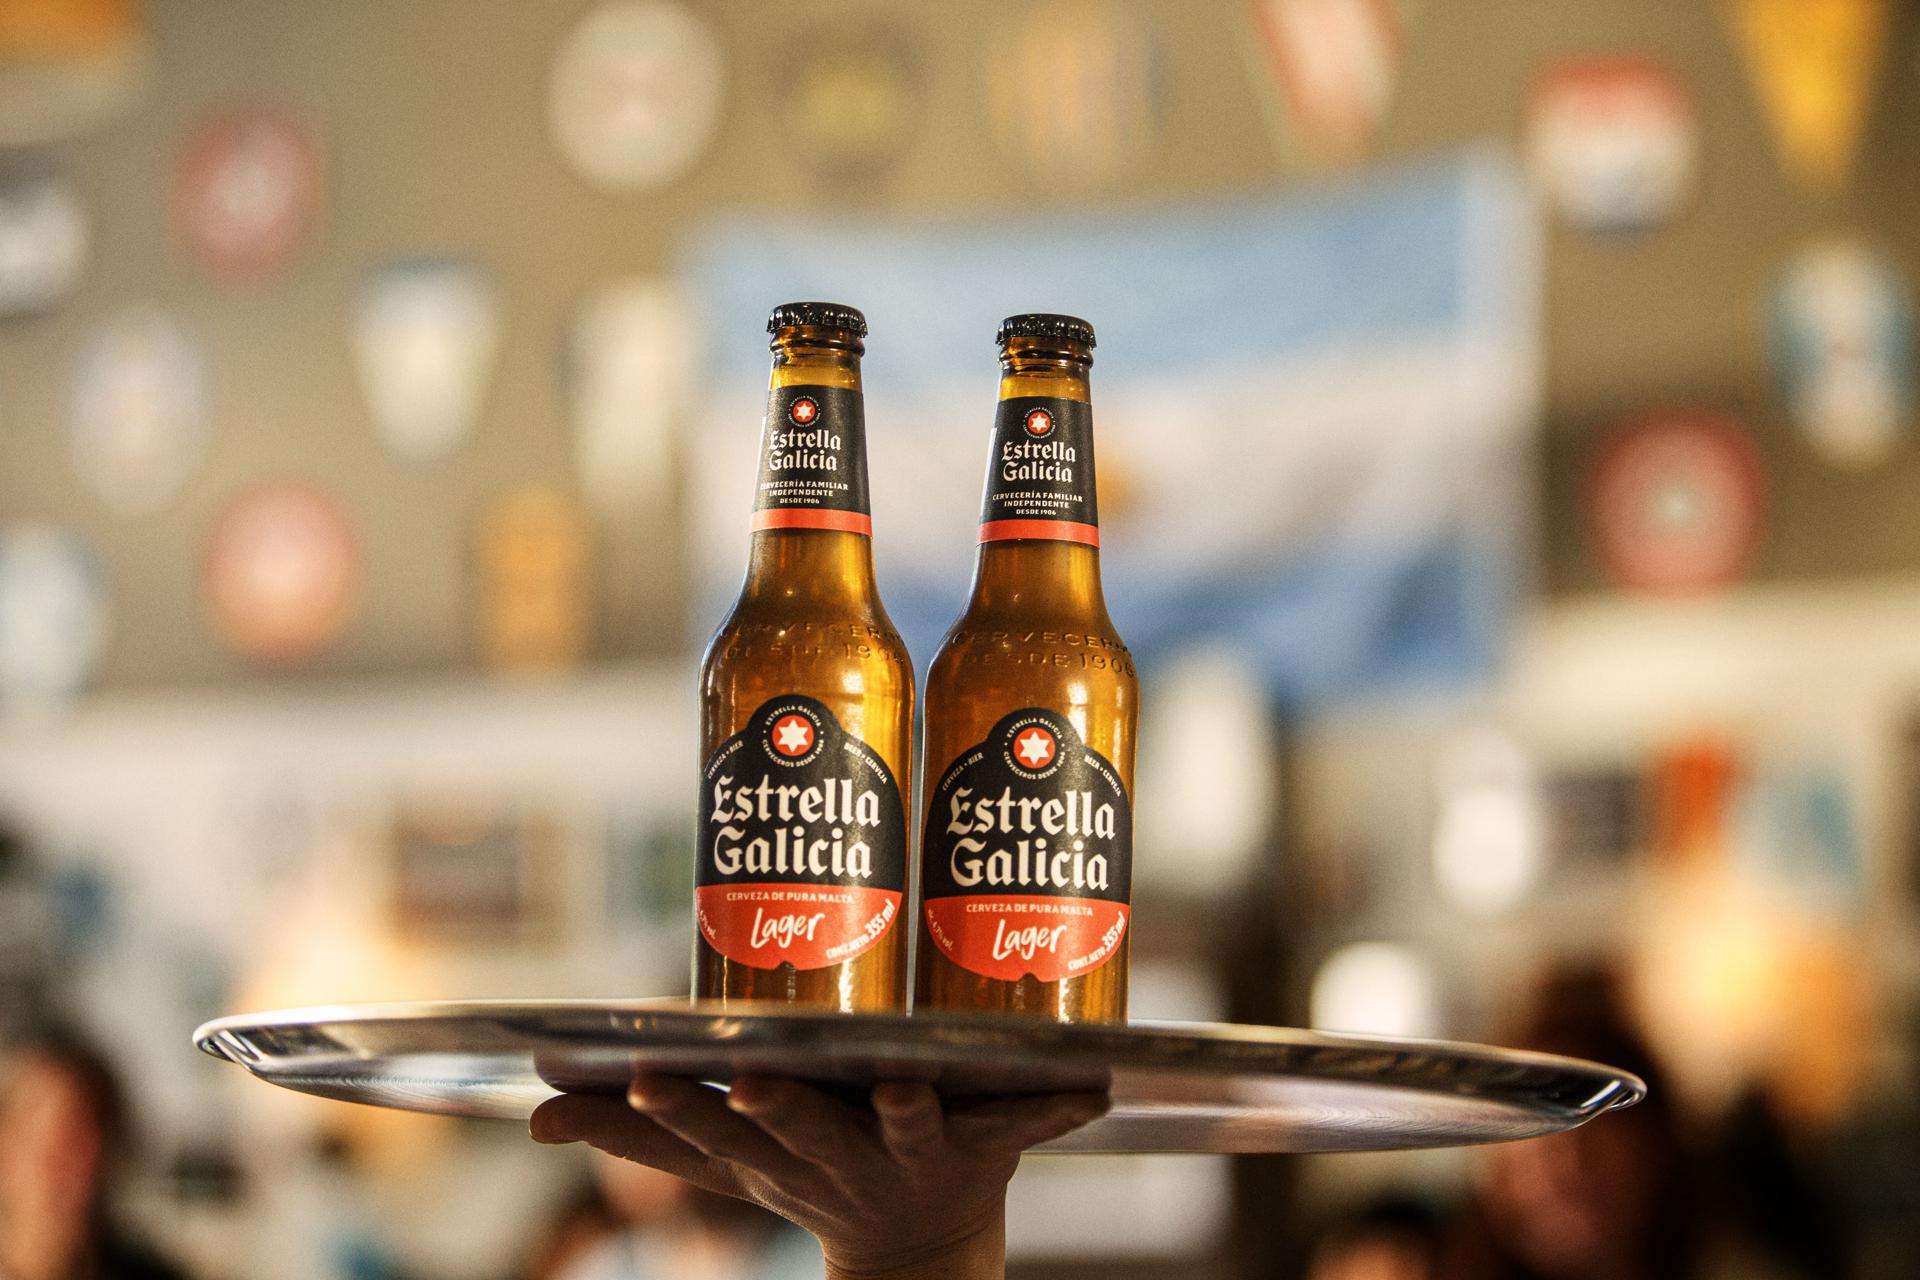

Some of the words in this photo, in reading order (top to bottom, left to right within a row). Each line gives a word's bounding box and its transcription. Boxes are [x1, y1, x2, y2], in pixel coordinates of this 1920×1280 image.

[769, 428, 841, 450] Estrella
[1001, 439, 1076, 462] Estrella
[769, 449, 837, 471] Galicia
[1003, 460, 1072, 483] Galicia
[806, 481, 849, 490] FAMILIAR
[992, 490, 1041, 501] CERVECERÍA
[1042, 492, 1083, 503] FAMILIAR
[765, 705, 796, 726] ESTRELLA
[797, 705, 822, 727] GALICIA
[1006, 717, 1038, 738] ESTRELLA
[1038, 717, 1063, 740] GALICIA
[762, 739, 795, 768] CERVECEROS
[1003, 751, 1037, 780] CERVECEROS
[710, 774, 881, 827] Estrella
[946, 786, 1116, 840] Estrella
[713, 825, 873, 879] Galicia
[951, 837, 1109, 891] Galicia
[726, 891, 769, 901] CERVEZA
[771, 892, 784, 901] DE
[786, 891, 817, 902] PURA
[818, 893, 855, 904] MALTA
[966, 903, 1012, 913] CERVEZA
[1014, 903, 1028, 913] DE
[1029, 903, 1059, 914] PURA
[1060, 904, 1094, 917] MALTA
[750, 907, 826, 949] Lager
[864, 913, 886, 940] 355
[881, 897, 896, 923] ml
[1102, 925, 1119, 952] 355
[1115, 910, 1126, 935] ml
[992, 918, 1068, 961] Lager
